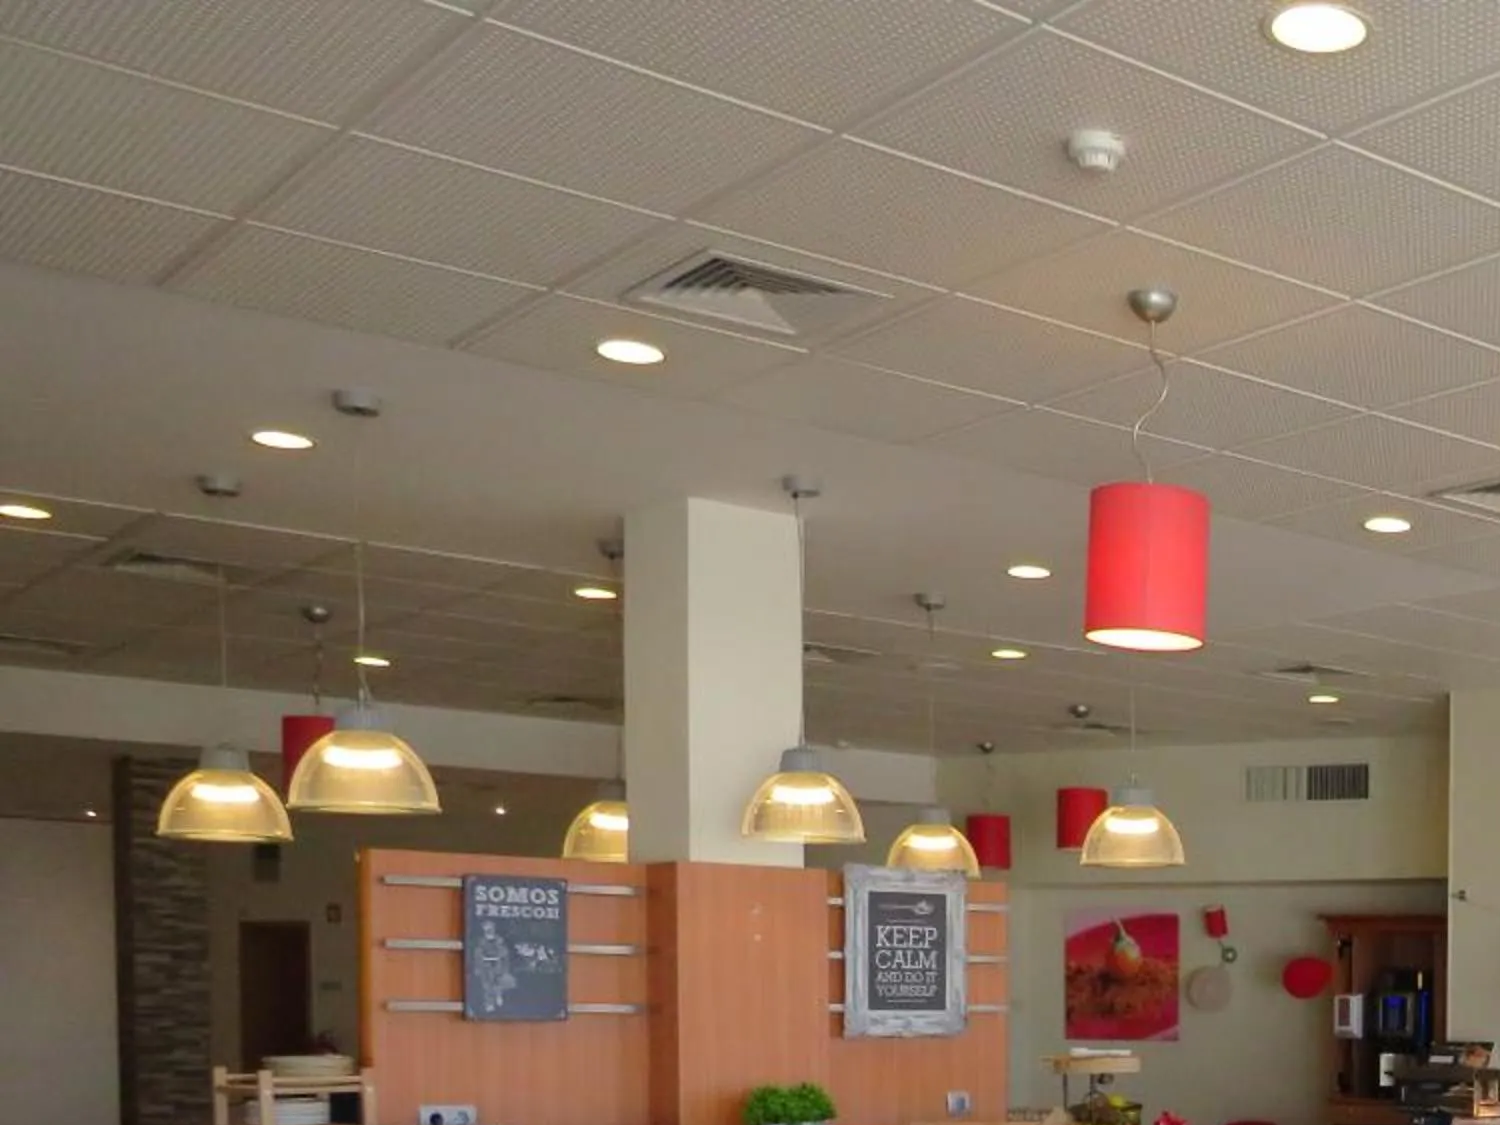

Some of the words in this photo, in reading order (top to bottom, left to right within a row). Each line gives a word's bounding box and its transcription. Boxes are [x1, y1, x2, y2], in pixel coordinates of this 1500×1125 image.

[475, 886, 559, 905] SOMOS
[876, 925, 938, 948] KEEP
[875, 949, 938, 970] CALM
[876, 971, 902, 983] AND
[904, 971, 924, 983] DO
[925, 971, 938, 984] IT
[876, 984, 938, 997] YOURSELF
